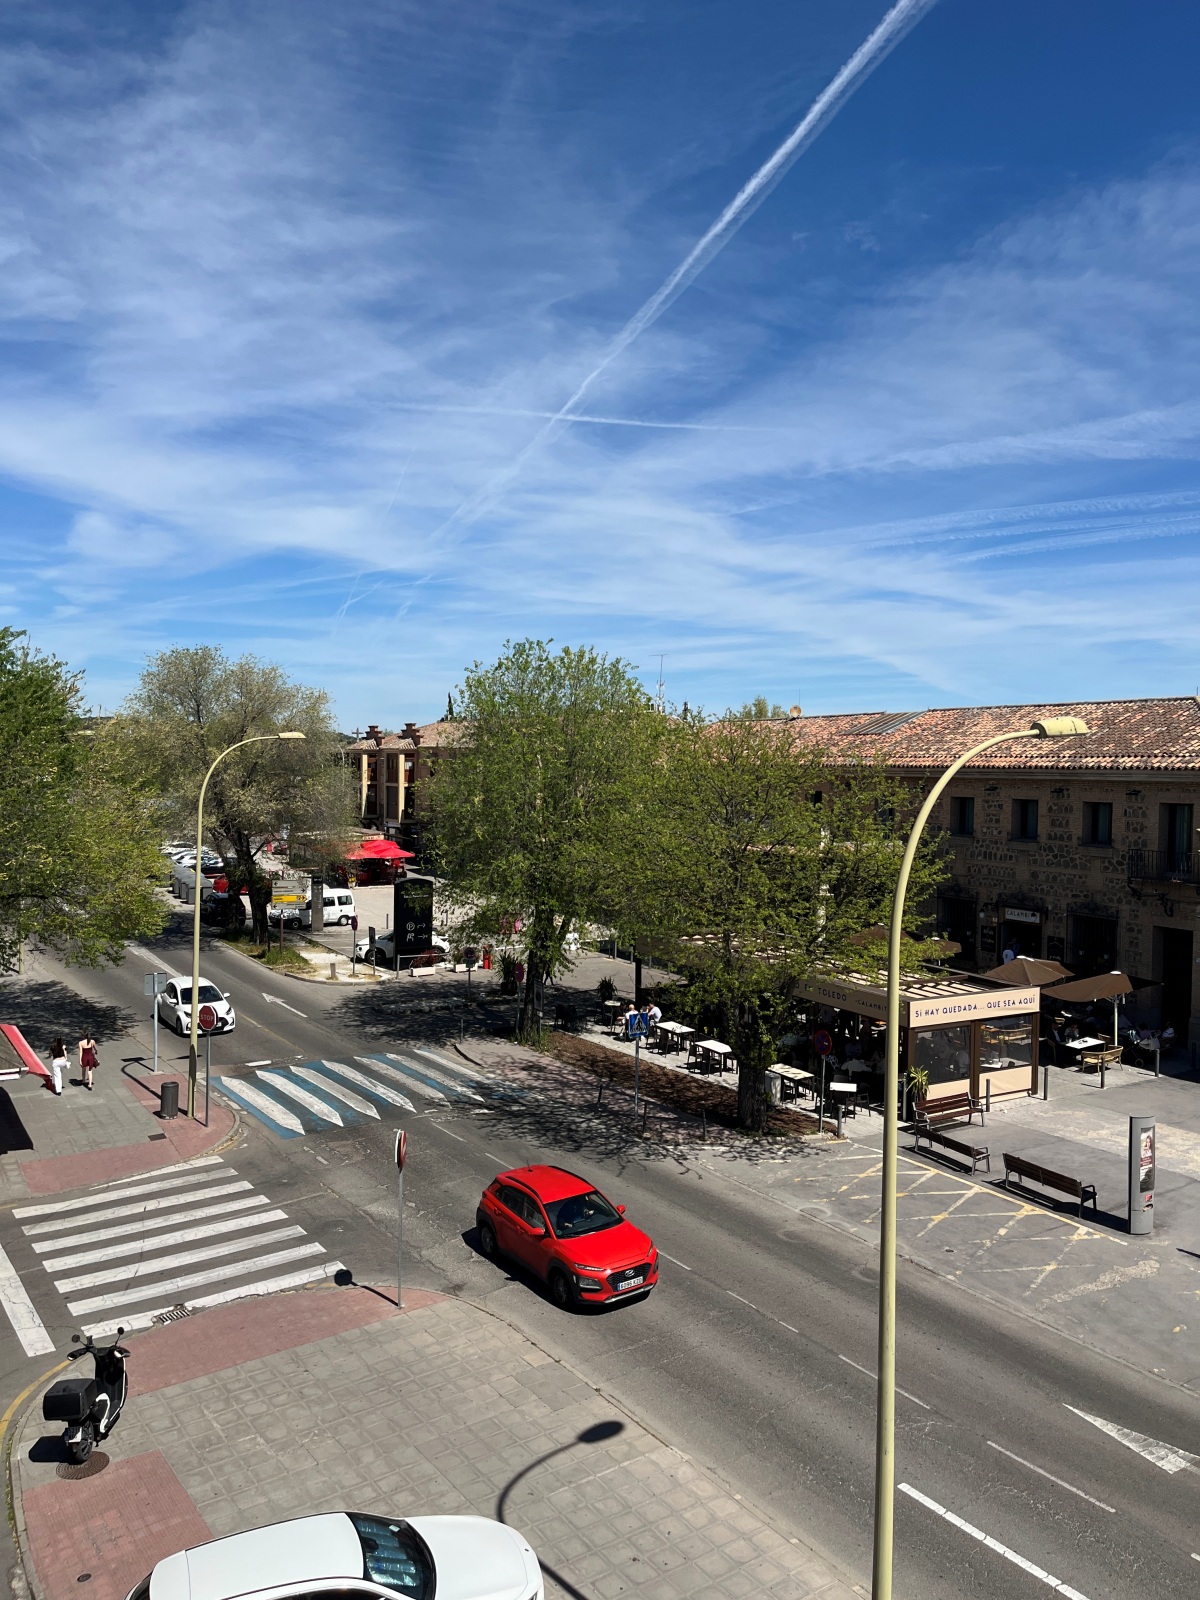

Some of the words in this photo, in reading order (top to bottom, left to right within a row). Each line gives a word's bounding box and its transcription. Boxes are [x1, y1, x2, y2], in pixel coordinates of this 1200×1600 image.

[818, 987, 847, 1001] TOLEDO
[924, 1008, 940, 1016] HAY
[986, 1001, 1001, 1009] QUE
[1003, 998, 1016, 1007] SEA
